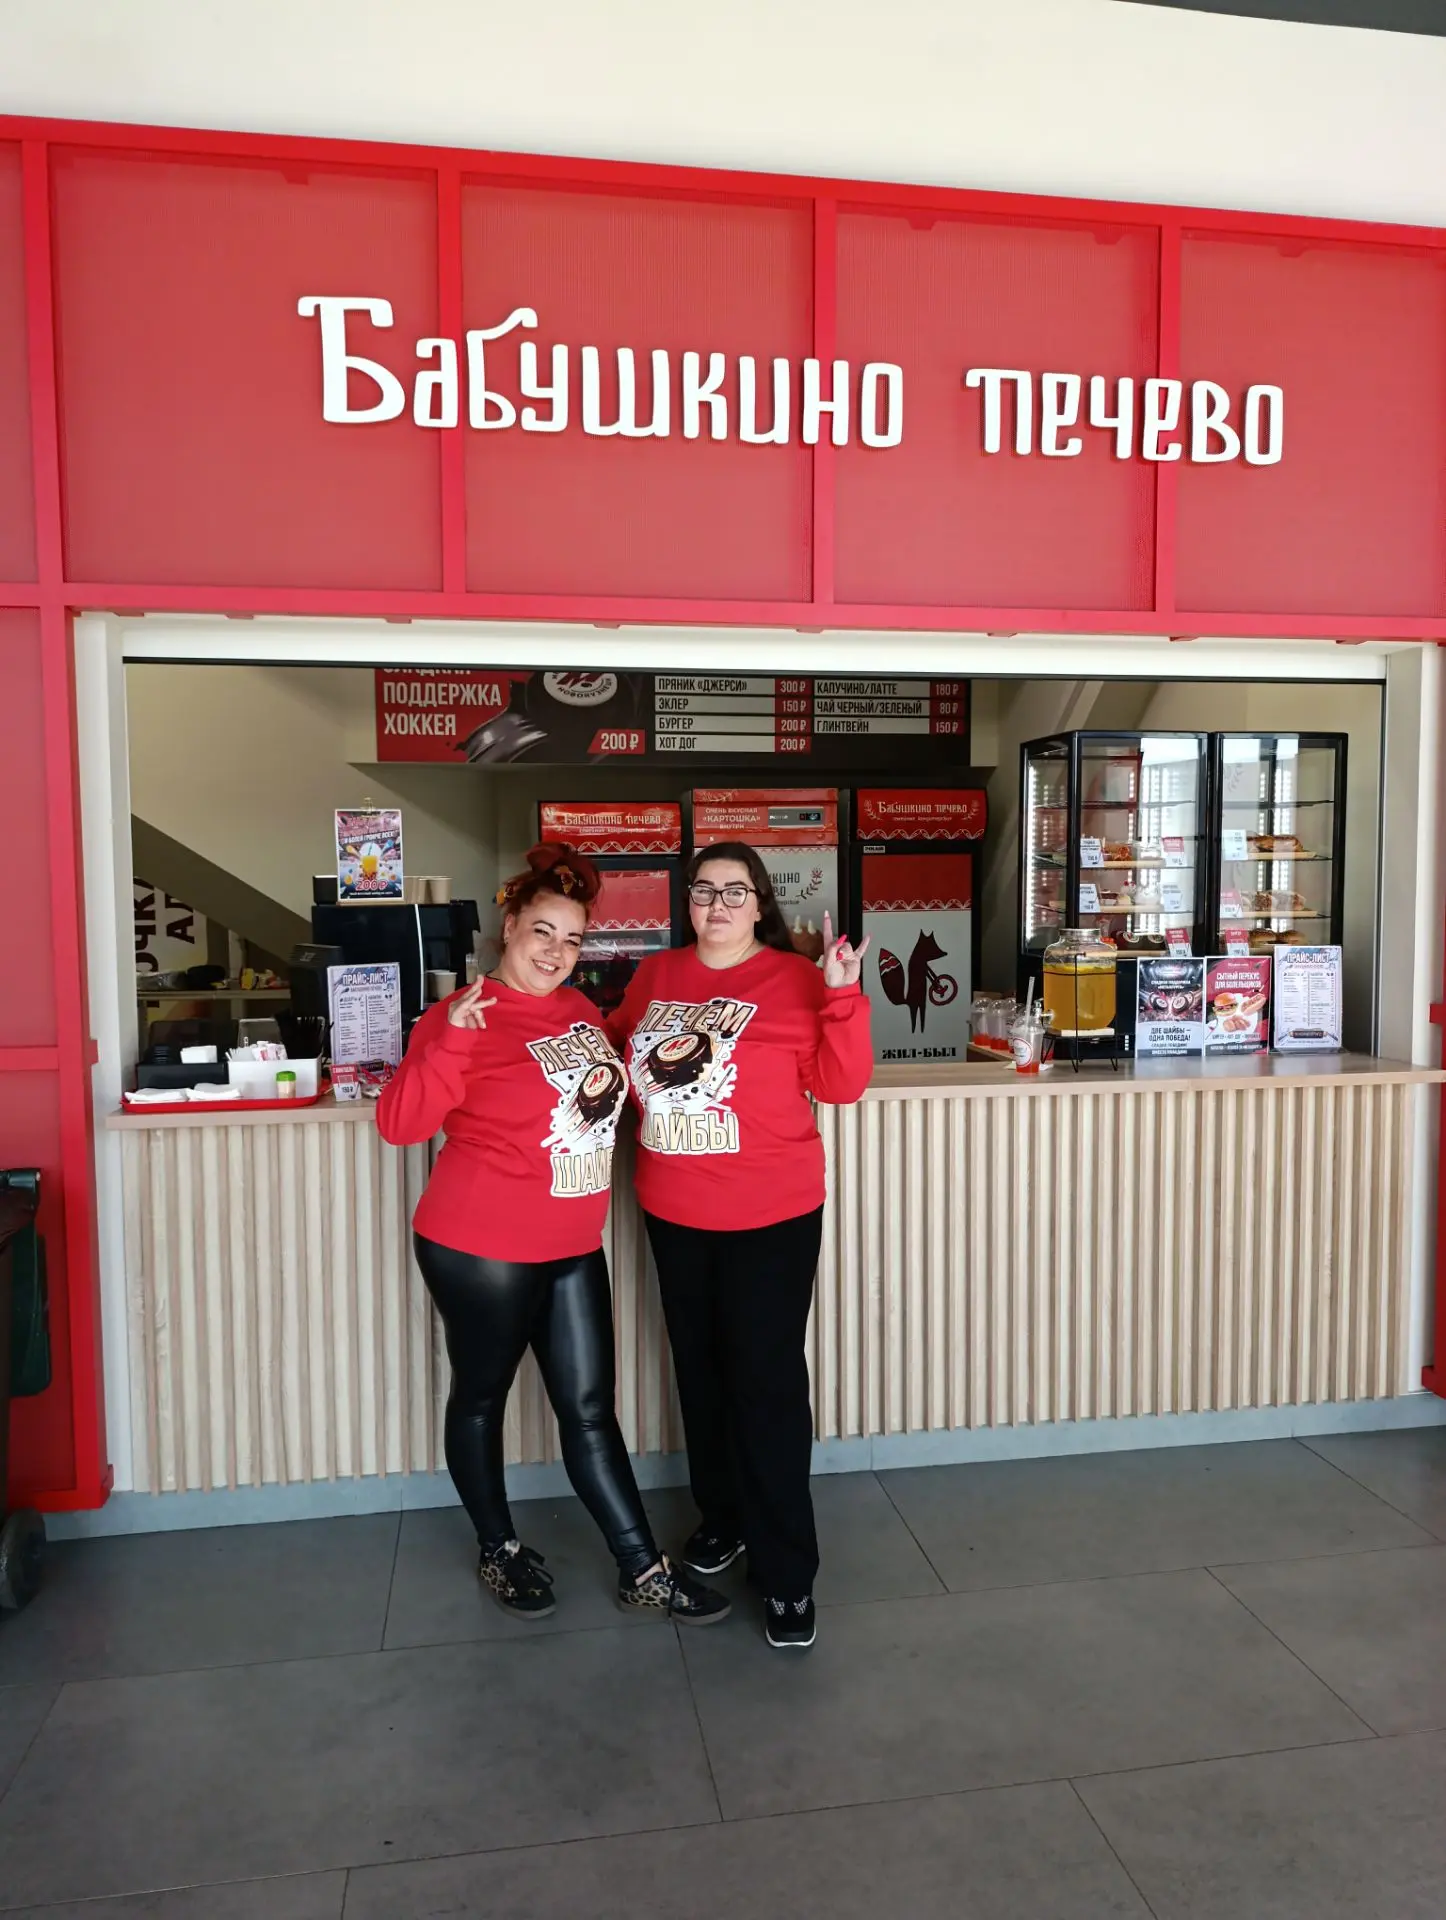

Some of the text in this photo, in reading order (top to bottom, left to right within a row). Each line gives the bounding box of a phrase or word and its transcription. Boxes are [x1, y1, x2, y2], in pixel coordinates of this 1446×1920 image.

[298, 296, 1284, 466] Бабушкино печево
[658, 678, 695, 691] ПРЯНИК
[698, 679, 747, 692] «ДЖЕРСИ»
[817, 682, 897, 695] КАПУЧИНО/ЛАТТЕ
[383, 681, 502, 708] ПОДДЕРЖКА
[659, 697, 688, 710] ЭКЛЕР
[817, 700, 835, 713] ЧАЙ
[837, 700, 922, 714] ЧЕРНЫЙ/ЗЕЛЕНЫЙ
[384, 712, 456, 736] ХОККЕЯ
[659, 717, 693, 730] БУРГЕР
[817, 719, 869, 732] ГЛИНТВЕЙН
[659, 737, 676, 749] ХОТ
[678, 737, 697, 750] ДОГ
[702, 814, 761, 823] «КАРТОШКА»
[882, 1047, 956, 1059] ЖИЛ-БЫЛ
